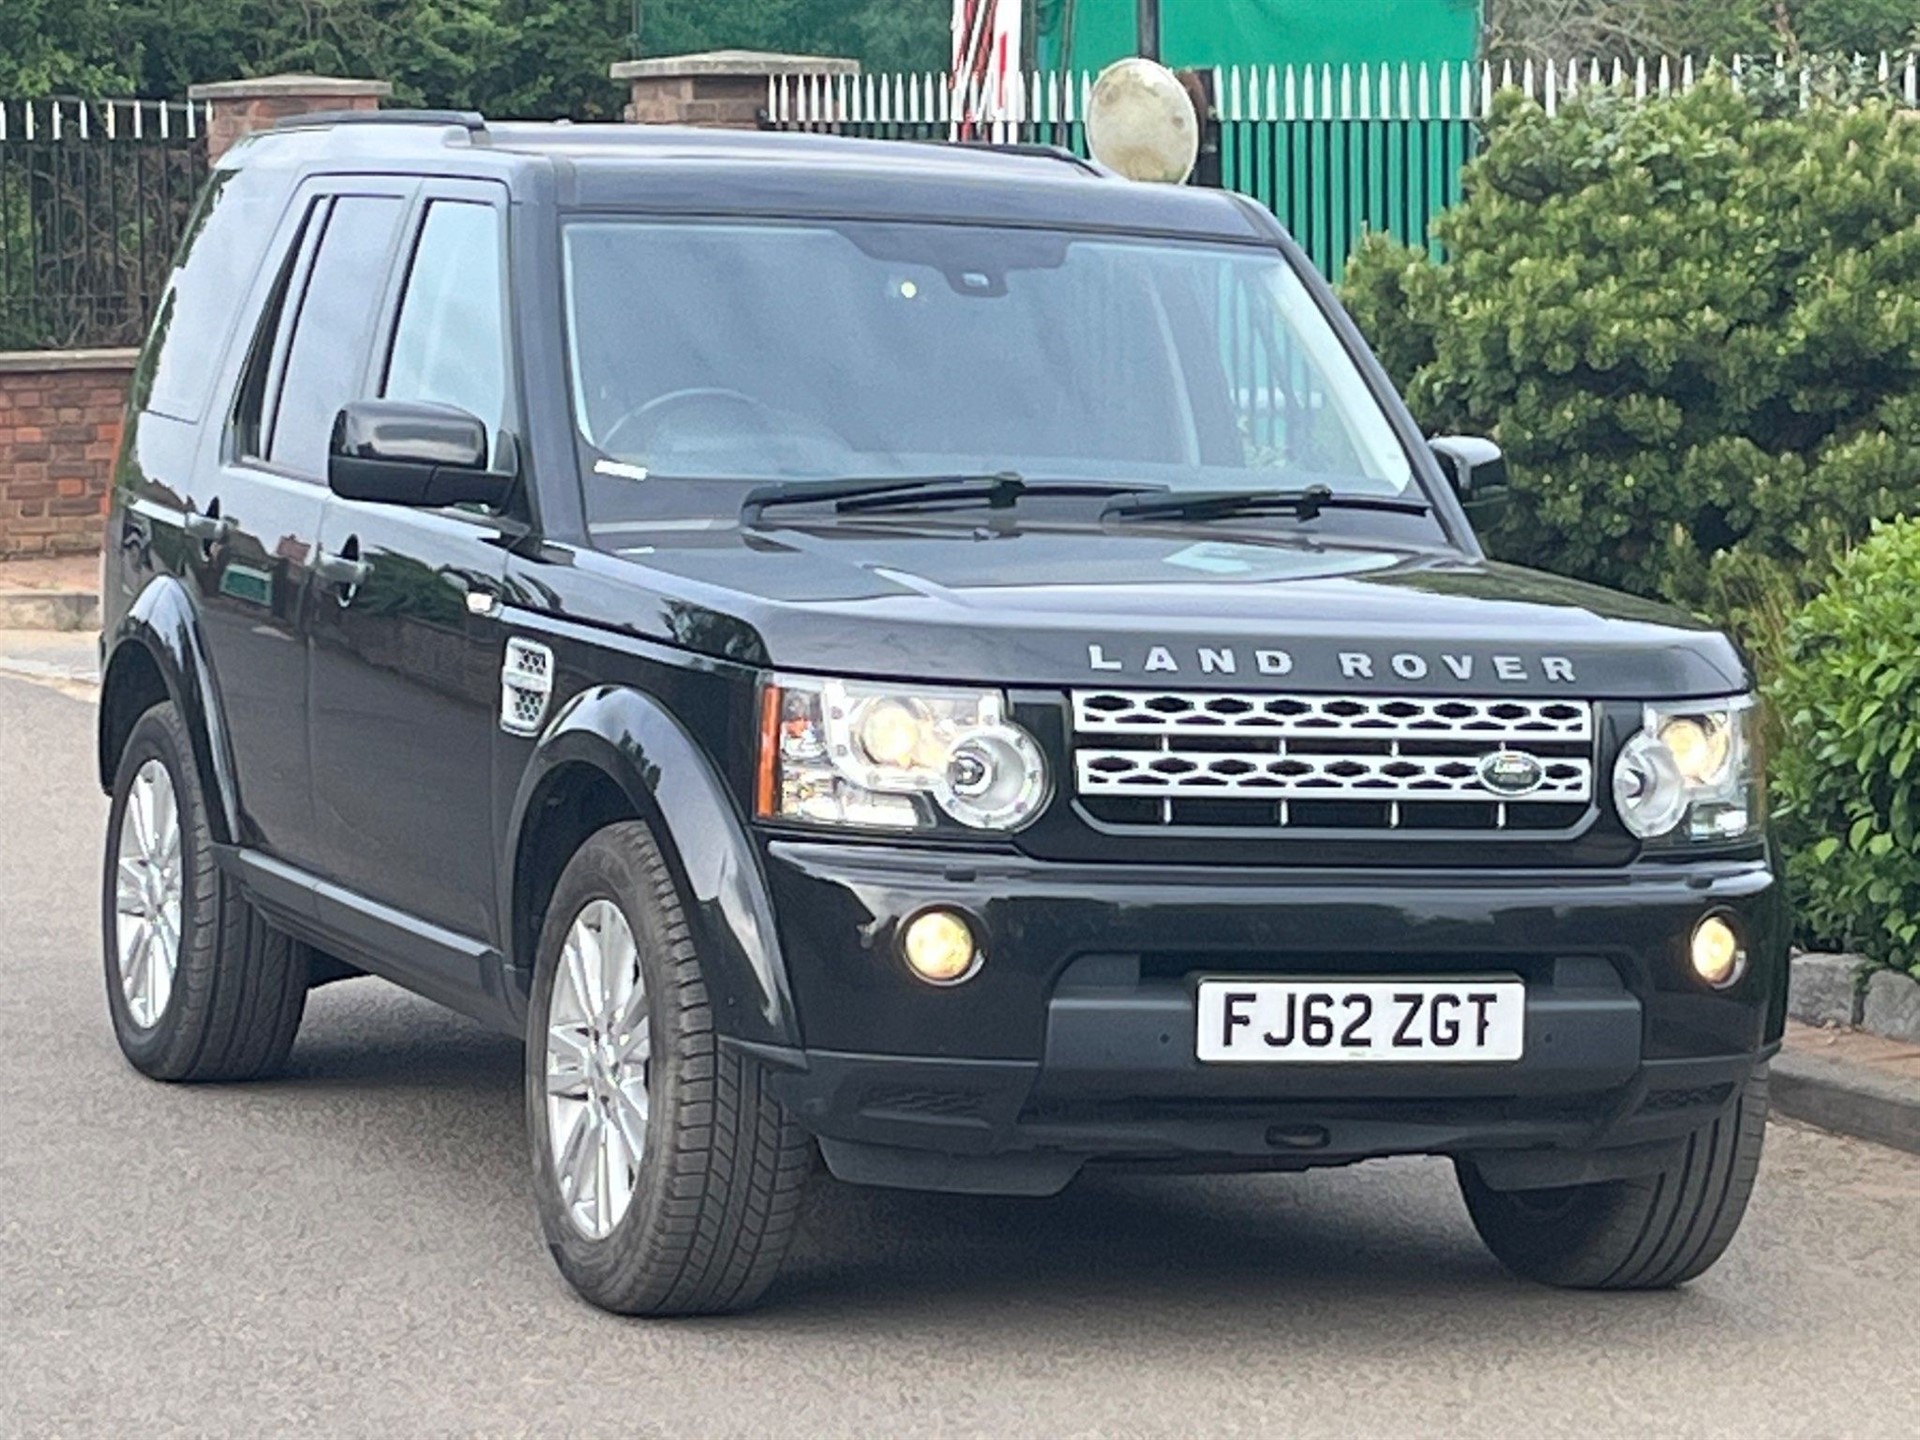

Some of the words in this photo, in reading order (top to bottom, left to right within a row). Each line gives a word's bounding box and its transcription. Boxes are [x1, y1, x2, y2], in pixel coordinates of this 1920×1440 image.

[1088, 645, 1293, 675] LAND
[1338, 652, 1576, 682] ROVER
[1223, 992, 1372, 1047] FJ62
[1391, 993, 1498, 1047] ZGT
